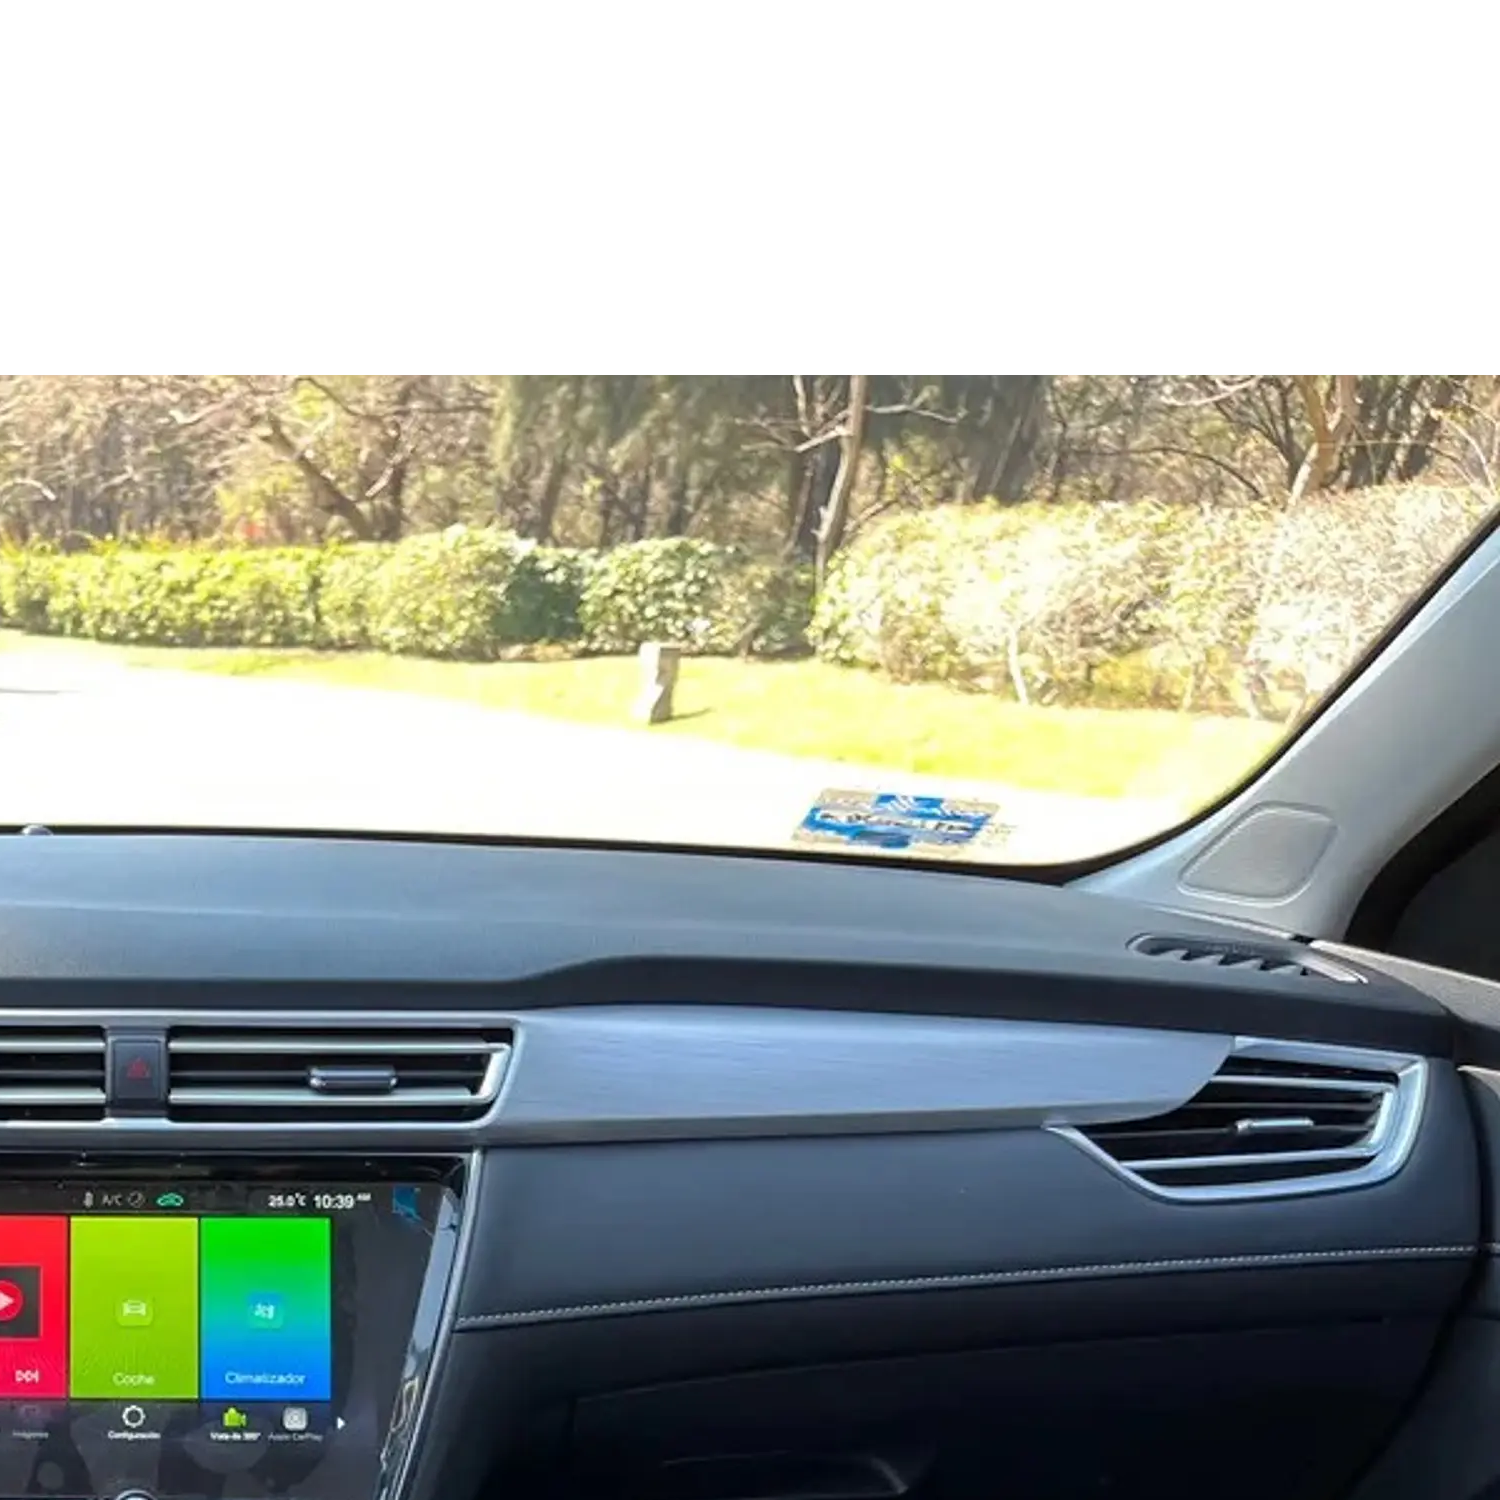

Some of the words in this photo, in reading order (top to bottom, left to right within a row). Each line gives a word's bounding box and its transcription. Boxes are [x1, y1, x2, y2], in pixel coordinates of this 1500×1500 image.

[314, 1194, 354, 1209] 10:39
[112, 1372, 155, 1386] Coche
[224, 1371, 306, 1384] Climatizador
